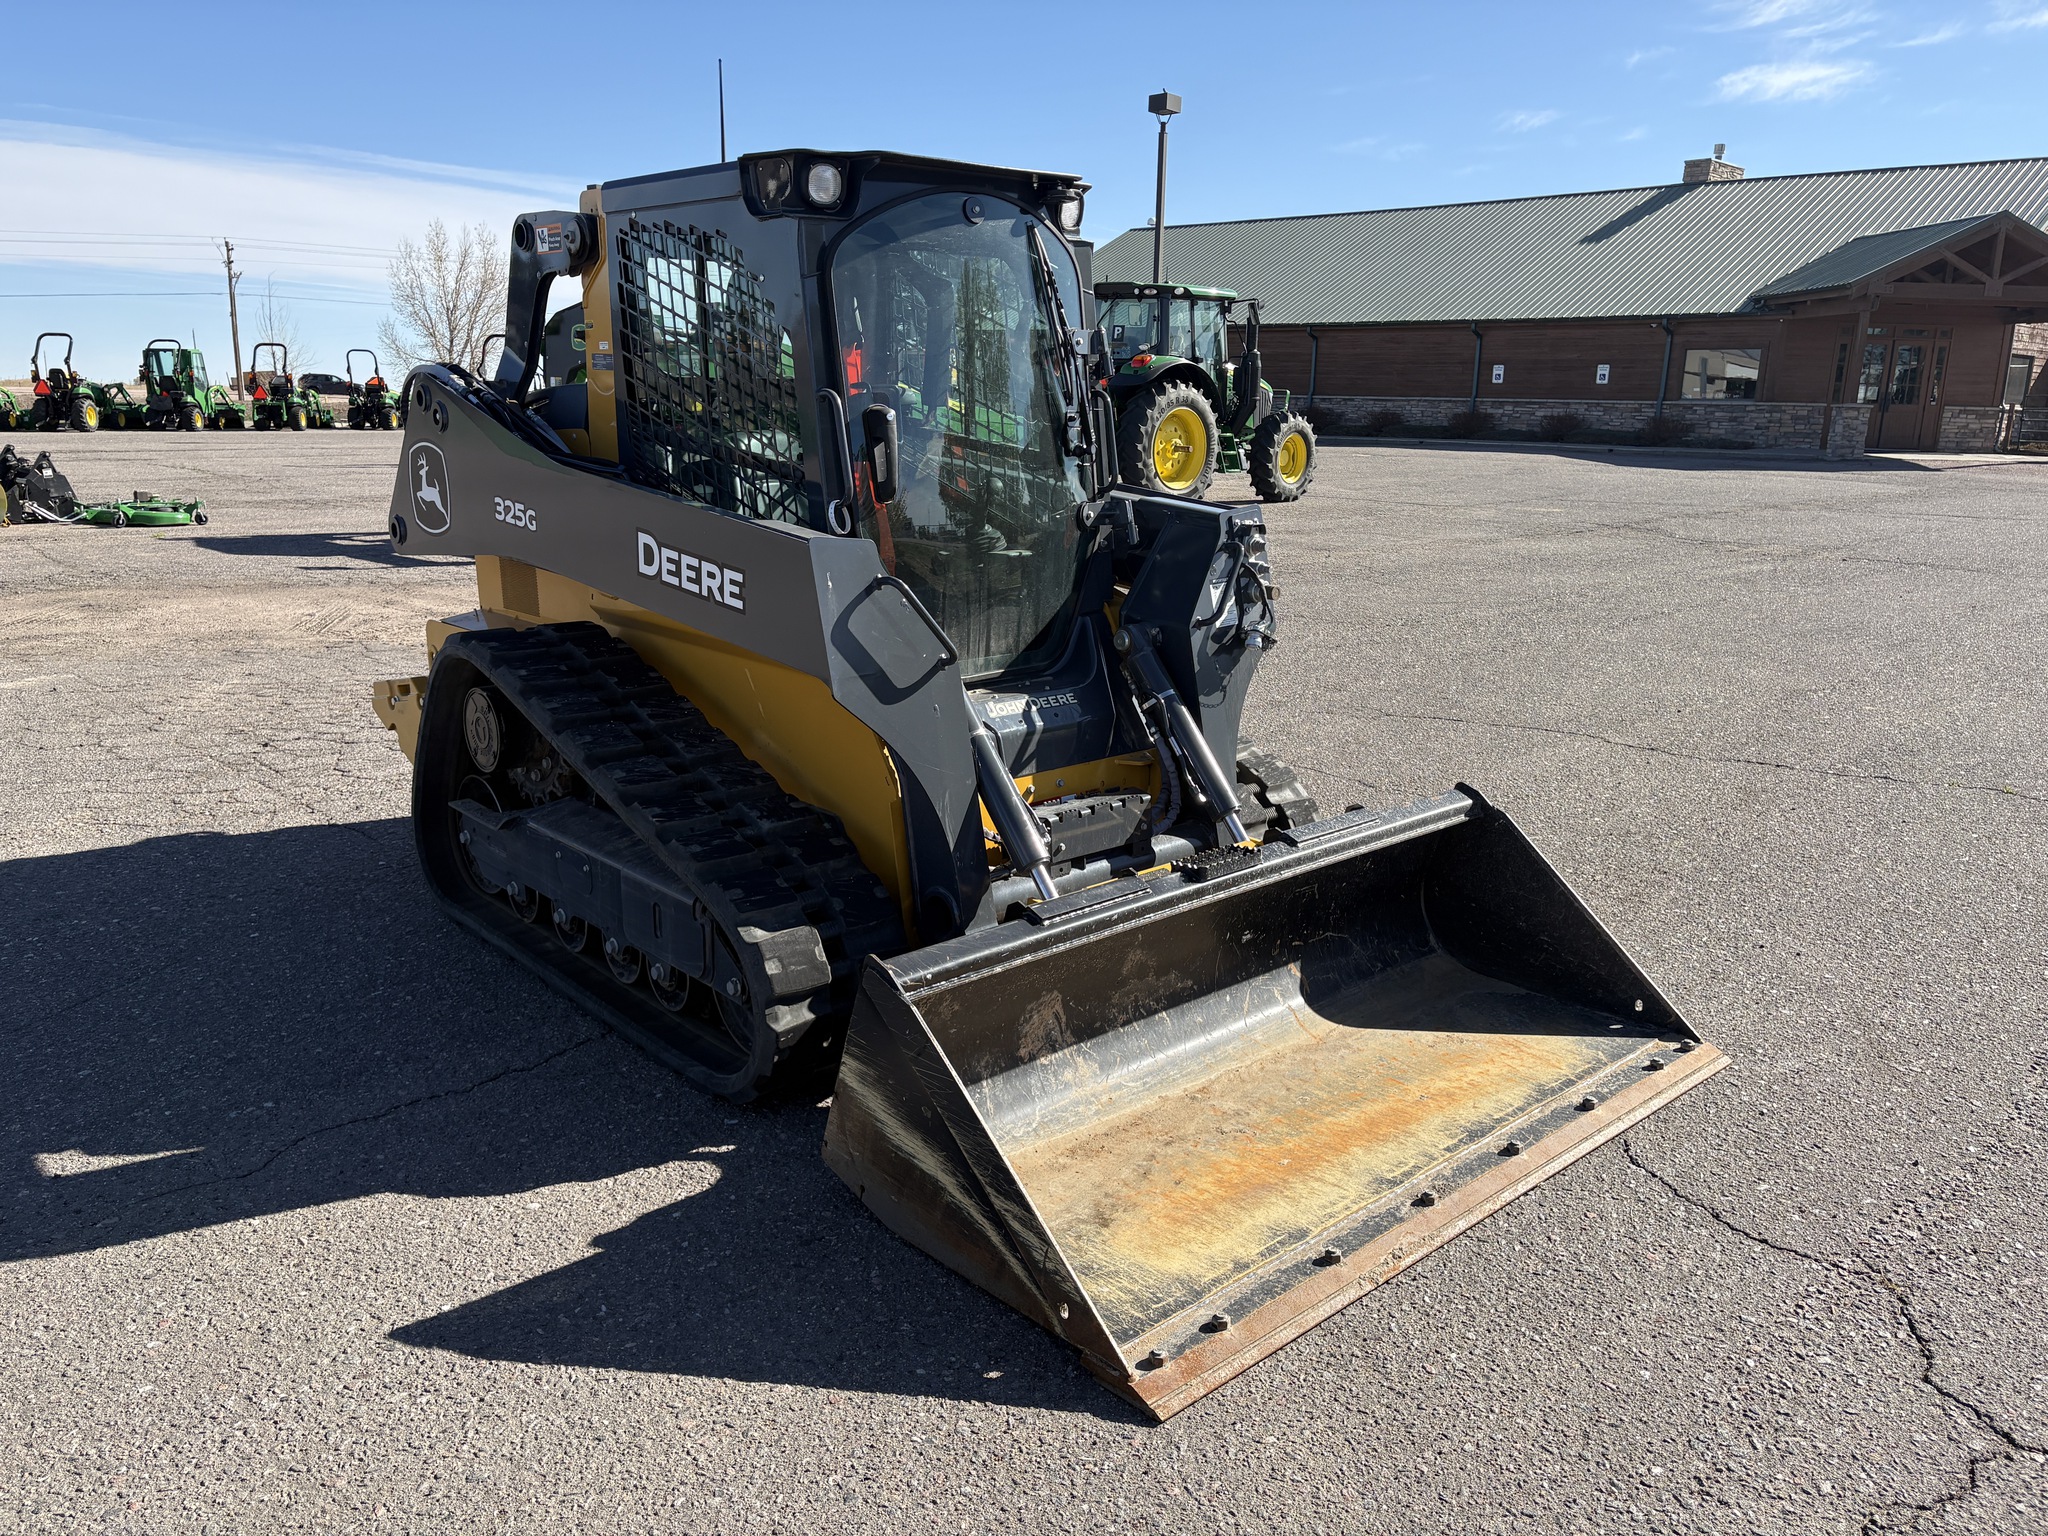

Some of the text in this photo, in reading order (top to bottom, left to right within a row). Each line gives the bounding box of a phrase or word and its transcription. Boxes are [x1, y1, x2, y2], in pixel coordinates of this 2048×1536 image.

[1114, 326, 1122, 339] P
[494, 496, 537, 532] 325G
[637, 531, 744, 610] DEERE
[985, 693, 1078, 718] JOHN DEERE
